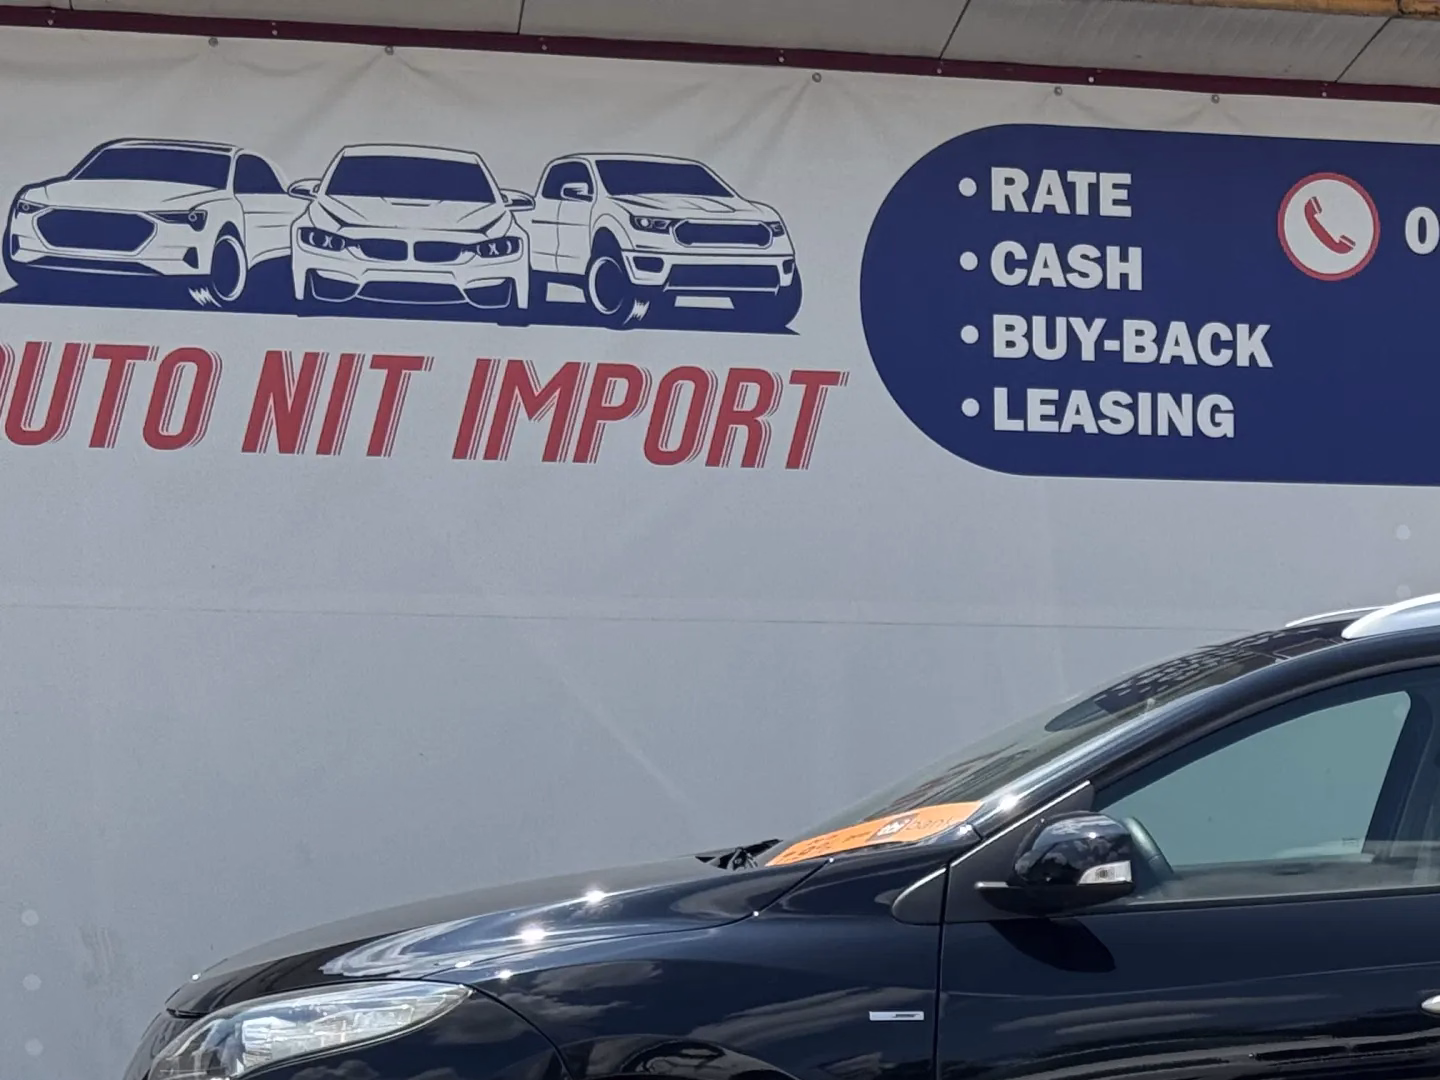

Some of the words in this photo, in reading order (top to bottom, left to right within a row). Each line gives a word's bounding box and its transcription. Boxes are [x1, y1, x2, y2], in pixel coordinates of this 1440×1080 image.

[990, 167, 1132, 218] RATE
[990, 240, 1143, 291] CASH
[992, 314, 1273, 368] BUY-BACK
[0, 340, 222, 450] UTO
[241, 349, 434, 458] NIT
[451, 358, 850, 470] IMPORT
[993, 387, 1235, 438] LEASING
